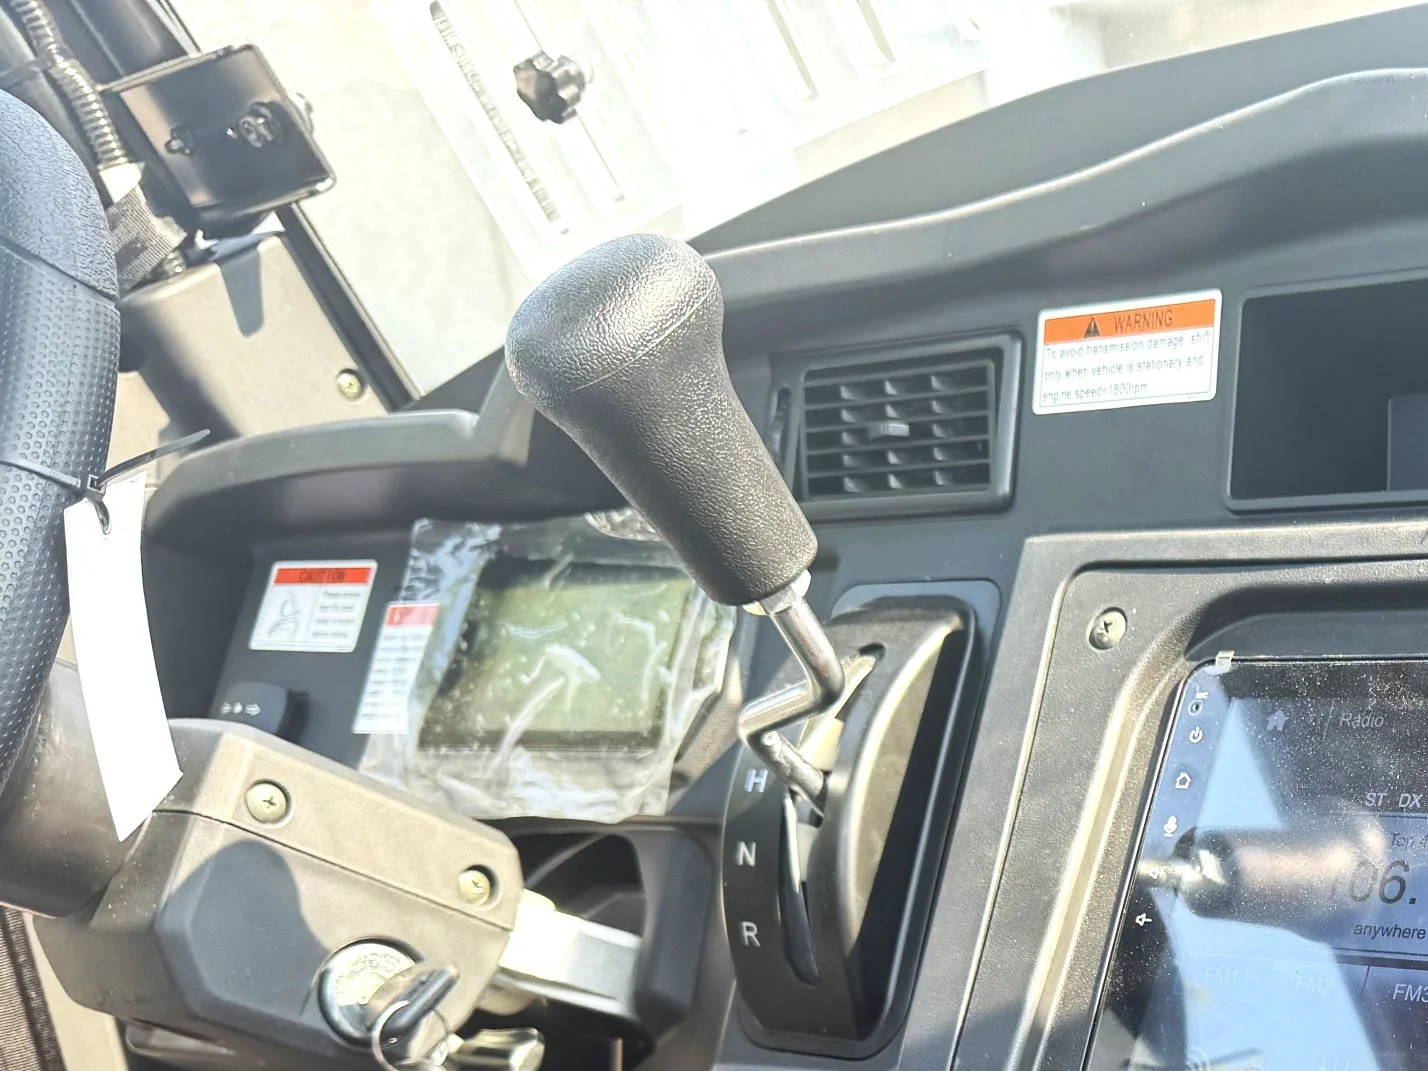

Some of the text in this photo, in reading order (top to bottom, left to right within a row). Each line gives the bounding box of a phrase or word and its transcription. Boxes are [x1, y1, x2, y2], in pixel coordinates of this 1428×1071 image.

[1115, 309, 1173, 333] WARNING
[1060, 347, 1083, 358] avoid
[1086, 340, 1144, 356] transmission
[1065, 367, 1088, 378] when
[1091, 361, 1123, 376] vehicle
[1137, 357, 1182, 371] stationary
[1186, 353, 1204, 367] and
[1042, 391, 1071, 404] engine
[1339, 712, 1384, 728] Radio
[744, 768, 769, 793] H
[1365, 792, 1422, 808] ST DX
[736, 841, 757, 867] N
[741, 921, 761, 948] R
[1353, 922, 1427, 941] anywhere
[1295, 977, 1334, 994] FM2
